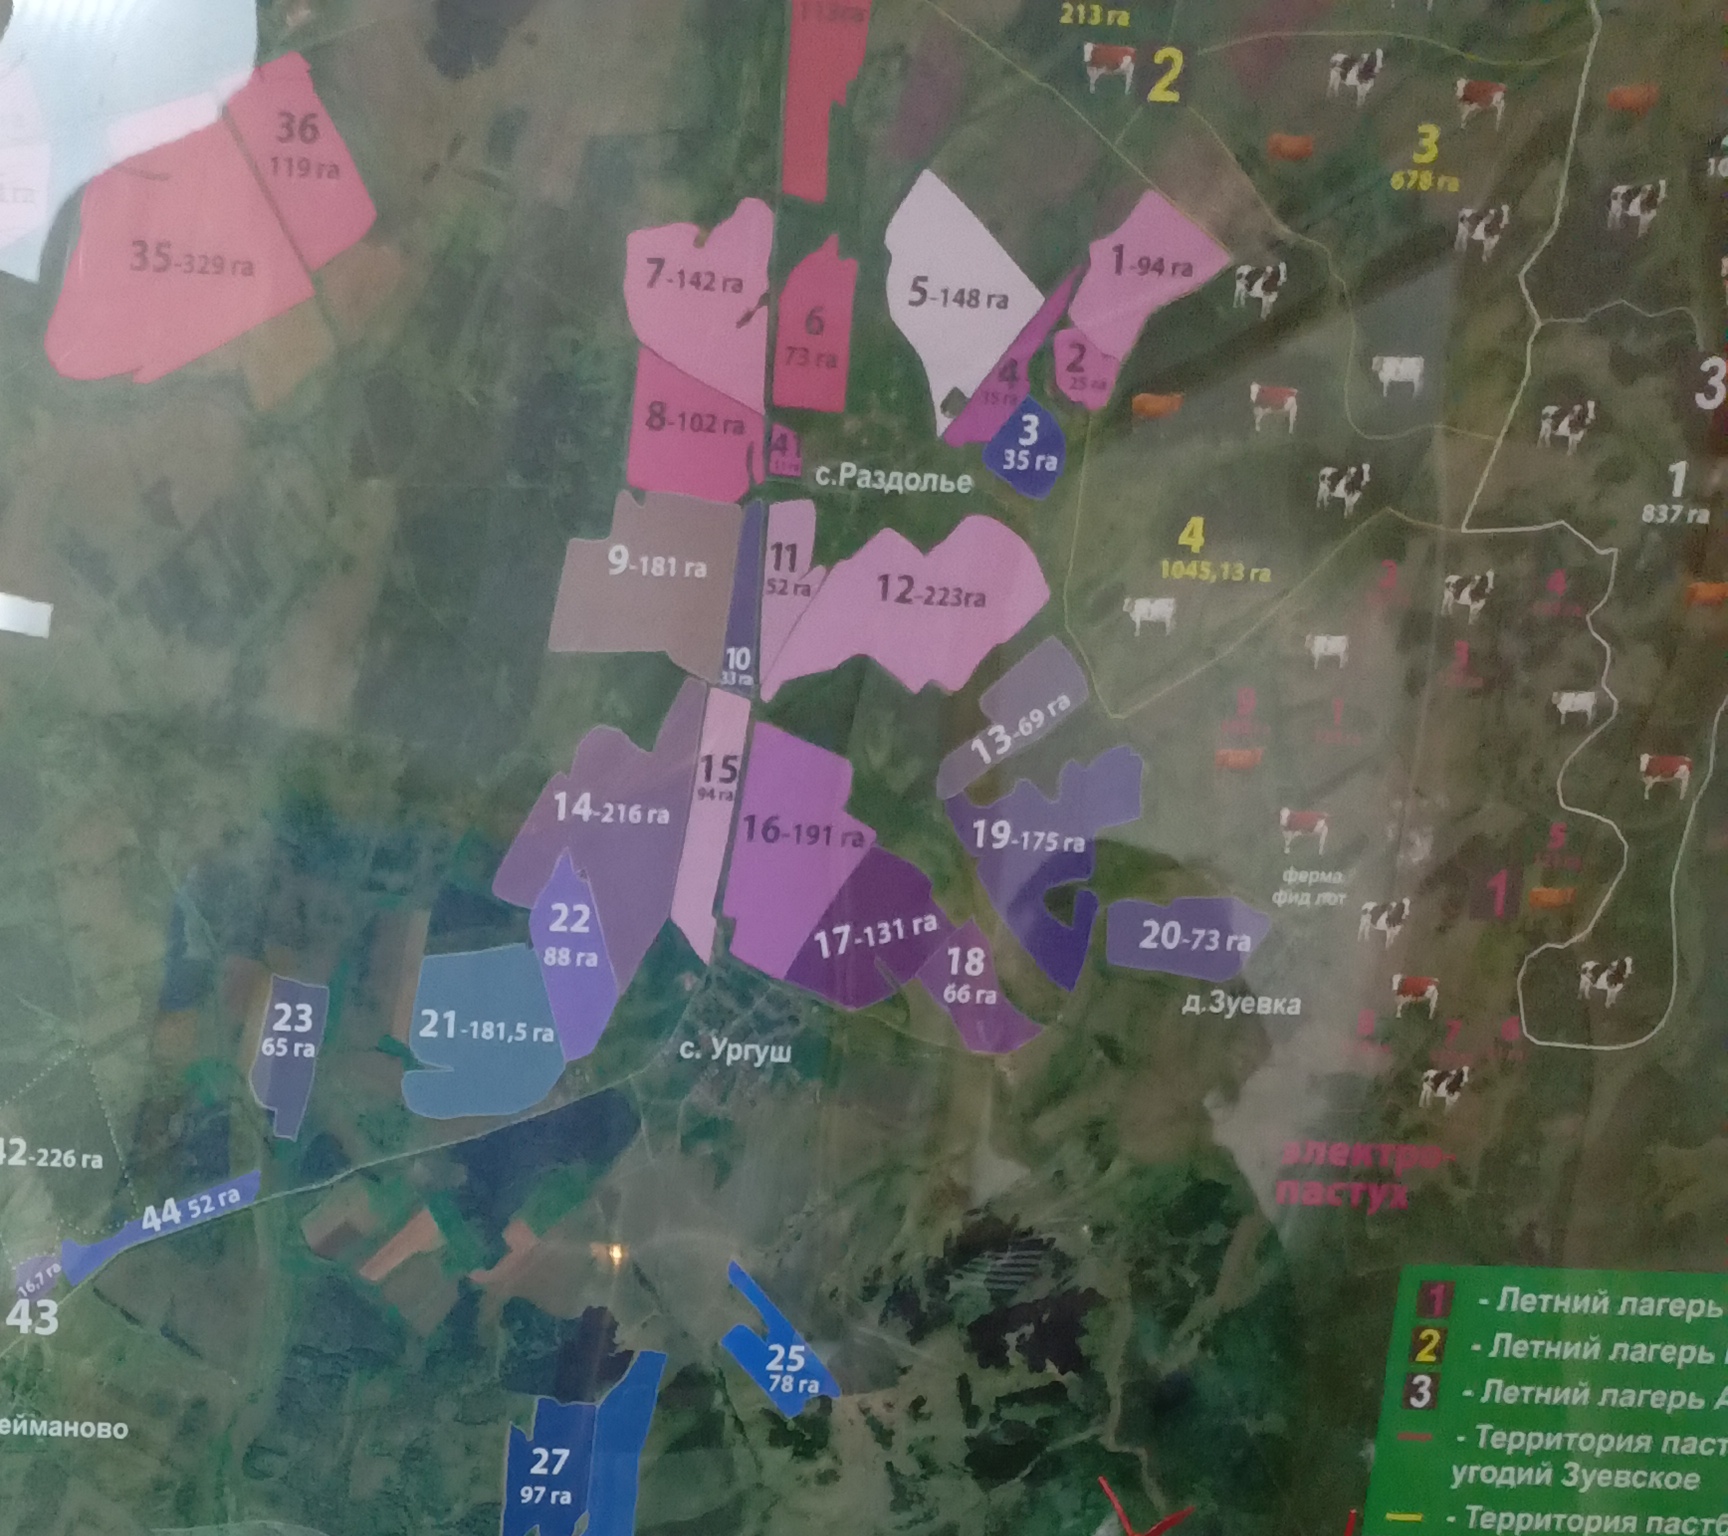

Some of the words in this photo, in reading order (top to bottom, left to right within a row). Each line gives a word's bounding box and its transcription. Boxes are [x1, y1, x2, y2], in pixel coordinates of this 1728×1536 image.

[1059, 2, 1102, 25] 213
[1147, 46, 1183, 102] 2
[276, 111, 320, 145] 36
[1412, 124, 1440, 164] 3
[270, 155, 311, 178] 119
[316, 161, 340, 180] га
[130, 239, 225, 275] 35-329
[231, 257, 255, 276] га
[1111, 244, 1165, 276] 1-94
[1171, 257, 1193, 277] га
[646, 257, 716, 291] 7-142
[722, 276, 744, 293] га
[908, 275, 981, 308] 5-148
[987, 292, 1009, 310] га
[805, 306, 825, 336] 6
[1066, 343, 1088, 373] 2
[1695, 356, 1727, 410] 3
[646, 400, 718, 434] 8-102
[723, 418, 745, 436] га
[1018, 414, 1040, 446] 3
[1003, 450, 1029, 470] 35
[1035, 453, 1058, 472] га
[1668, 460, 1689, 498] 1
[1642, 503, 1684, 524] 837
[1687, 508, 1710, 525] га
[1178, 516, 1204, 553] 4
[608, 544, 676, 576] 9-181
[684, 561, 707, 578] га
[770, 542, 798, 573] 11
[766, 578, 788, 596] 52
[793, 582, 811, 598] га
[1249, 567, 1271, 583] га
[725, 647, 750, 671] 10
[971, 709, 1045, 764] 13-69
[1047, 694, 1071, 717] га
[701, 754, 738, 784] 15
[554, 791, 642, 824] 14-216
[647, 808, 669, 824] га
[743, 814, 832, 847] 16-191
[841, 830, 865, 848] га
[973, 819, 1059, 851] 19-175
[1063, 837, 1085, 853] га
[1486, 868, 1508, 918] 1
[548, 903, 591, 933] 22
[1138, 918, 1221, 951] 20-73
[1226, 933, 1252, 952] га
[814, 918, 904, 959] 17-131
[912, 913, 938, 936] га
[543, 947, 571, 967] 88
[575, 950, 598, 968] га
[947, 946, 986, 977] 18
[943, 984, 971, 1004] 66
[976, 989, 997, 1005] га
[272, 1003, 314, 1033] 23
[418, 1008, 528, 1044] 21-181,5
[532, 1027, 554, 1042] га
[261, 1037, 288, 1057] 65
[293, 1040, 315, 1058] га
[679, 1039, 702, 1060] с.
[711, 1036, 792, 1068] Ургуш
[81, 1153, 104, 1169] га
[142, 1197, 181, 1232] 44
[187, 1195, 215, 1219] 52
[217, 1187, 241, 1208] га
[1275, 1179, 1409, 1217] пастух
[17, 1271, 45, 1298] 16,7
[46, 1261, 62, 1280] га
[5, 1297, 60, 1336] 43
[1428, 1284, 1446, 1318] 1
[1496, 1285, 1610, 1315] Летний
[1618, 1295, 1724, 1324] лагерь
[765, 1343, 806, 1372] 25
[1415, 1328, 1441, 1362] 2
[1488, 1332, 1600, 1361] Летний
[1608, 1343, 1715, 1370] лагерь
[768, 1374, 794, 1393] 78
[798, 1379, 820, 1394] га
[1409, 1374, 1432, 1408] 3
[1480, 1378, 1590, 1406] Летний
[1597, 1389, 1706, 1415] лагерь
[1475, 1423, 1653, 1457] Территория
[529, 1447, 570, 1476] 27
[1450, 1460, 1553, 1489] угодий
[1560, 1461, 1701, 1494] Зуевское
[520, 1486, 546, 1504] 97
[550, 1490, 572, 1505] га
